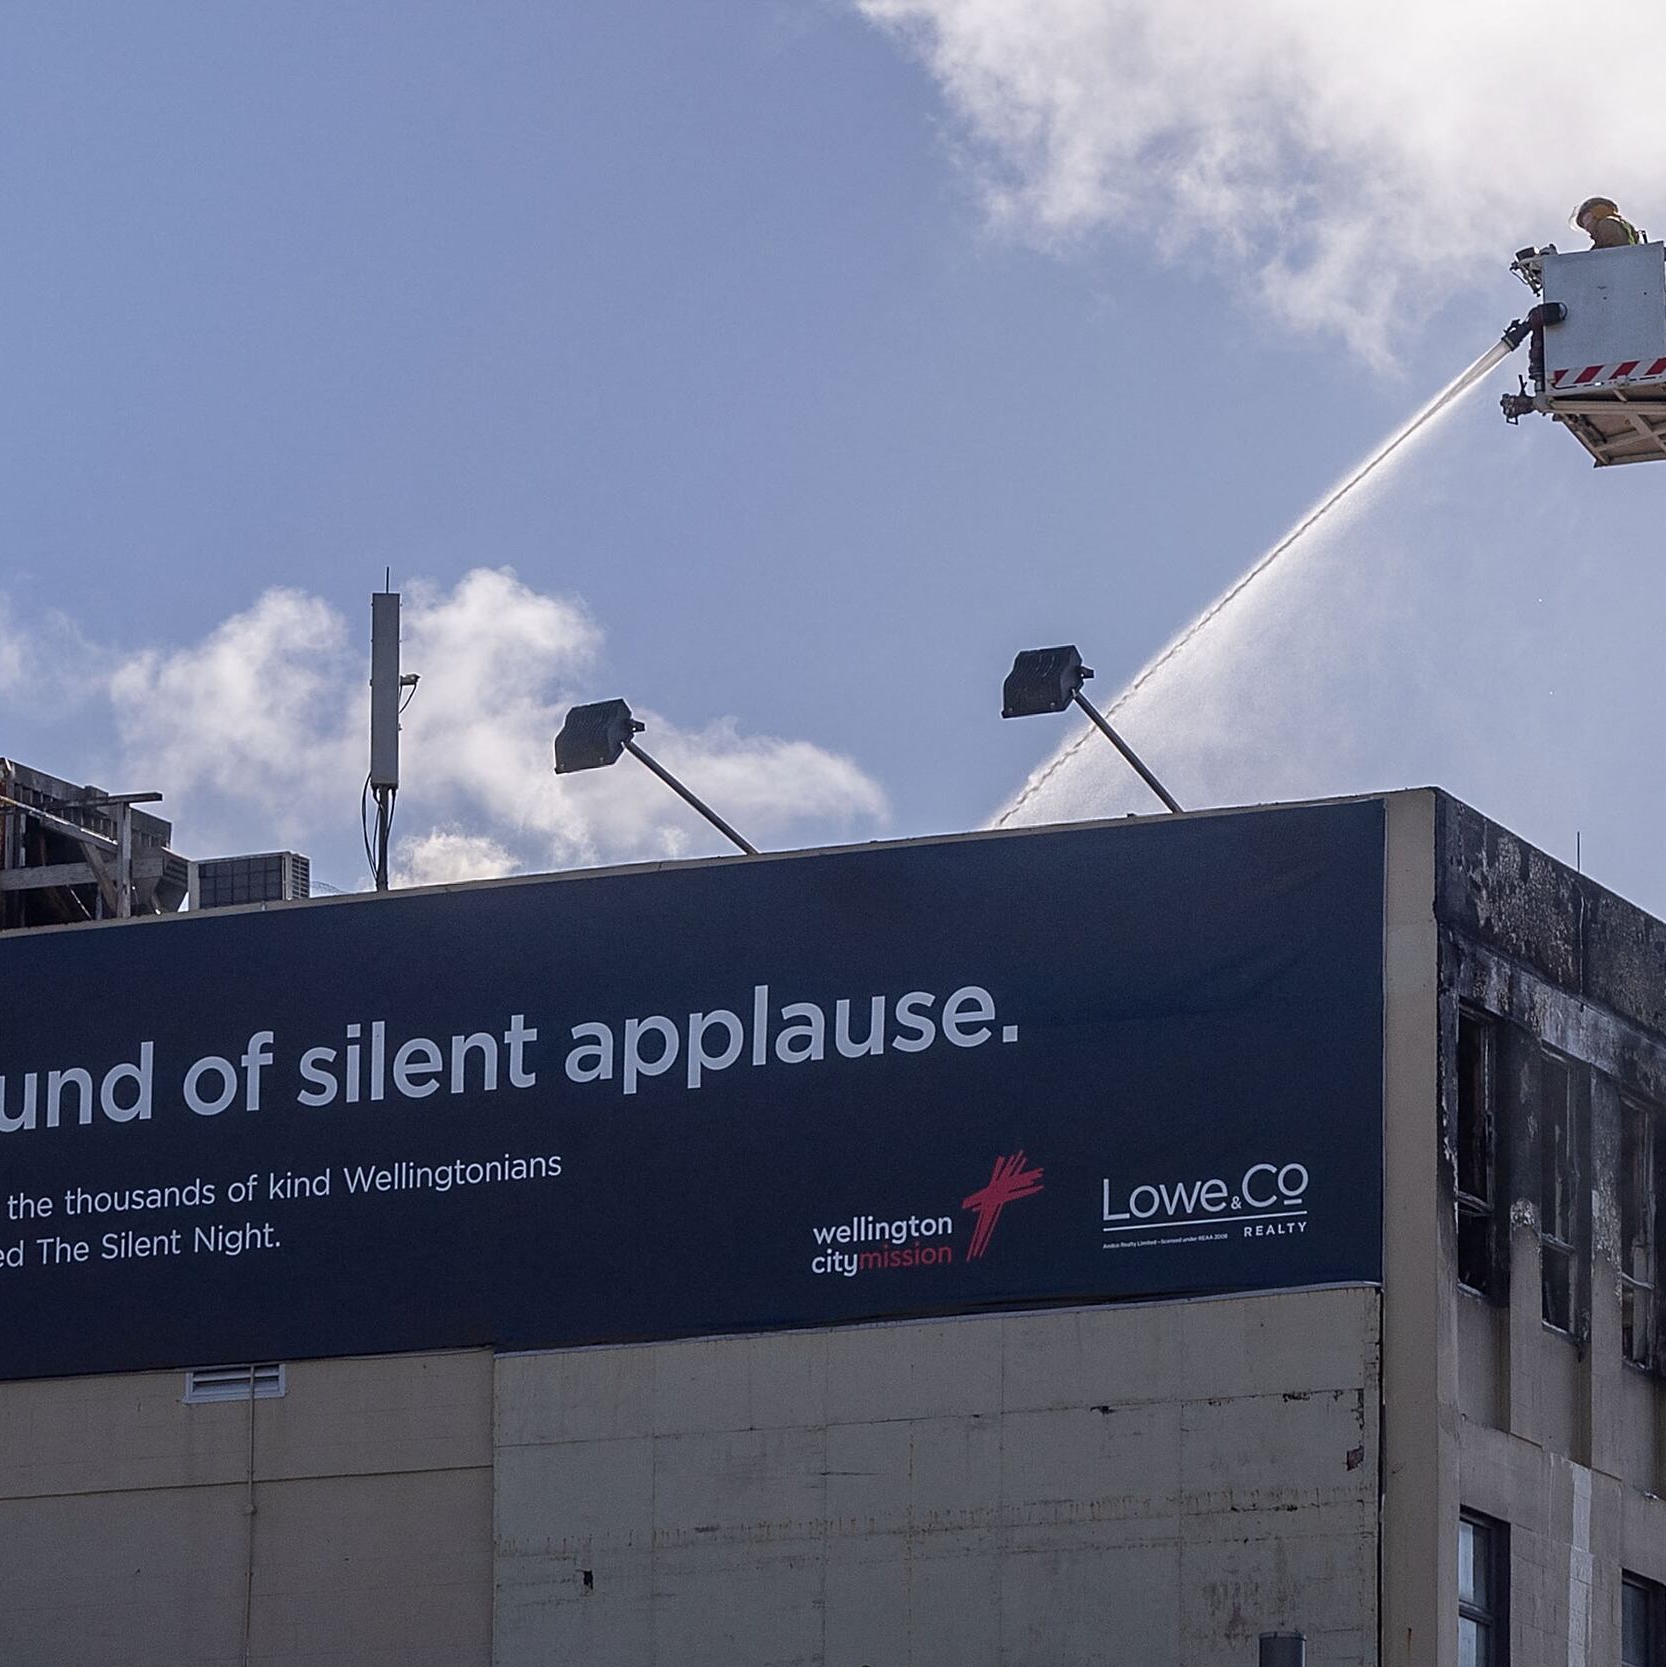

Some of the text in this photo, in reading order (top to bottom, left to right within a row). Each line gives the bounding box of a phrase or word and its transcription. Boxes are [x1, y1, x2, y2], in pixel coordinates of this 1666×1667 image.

[183, 1031, 274, 1116] of
[296, 1014, 538, 1107] silent
[564, 985, 1019, 1095] applause.
[7, 1192, 54, 1220] the
[64, 1178, 216, 1215] thousands
[227, 1174, 259, 1203] of
[269, 1168, 331, 1200] kind
[343, 1153, 563, 1194] Wellingtonians
[36, 1237, 90, 1265] The
[101, 1230, 182, 1260] Silent
[194, 1222, 282, 1256] Night.
[813, 1215, 953, 1245] wellington
[1244, 1221, 1308, 1238] REALTY
